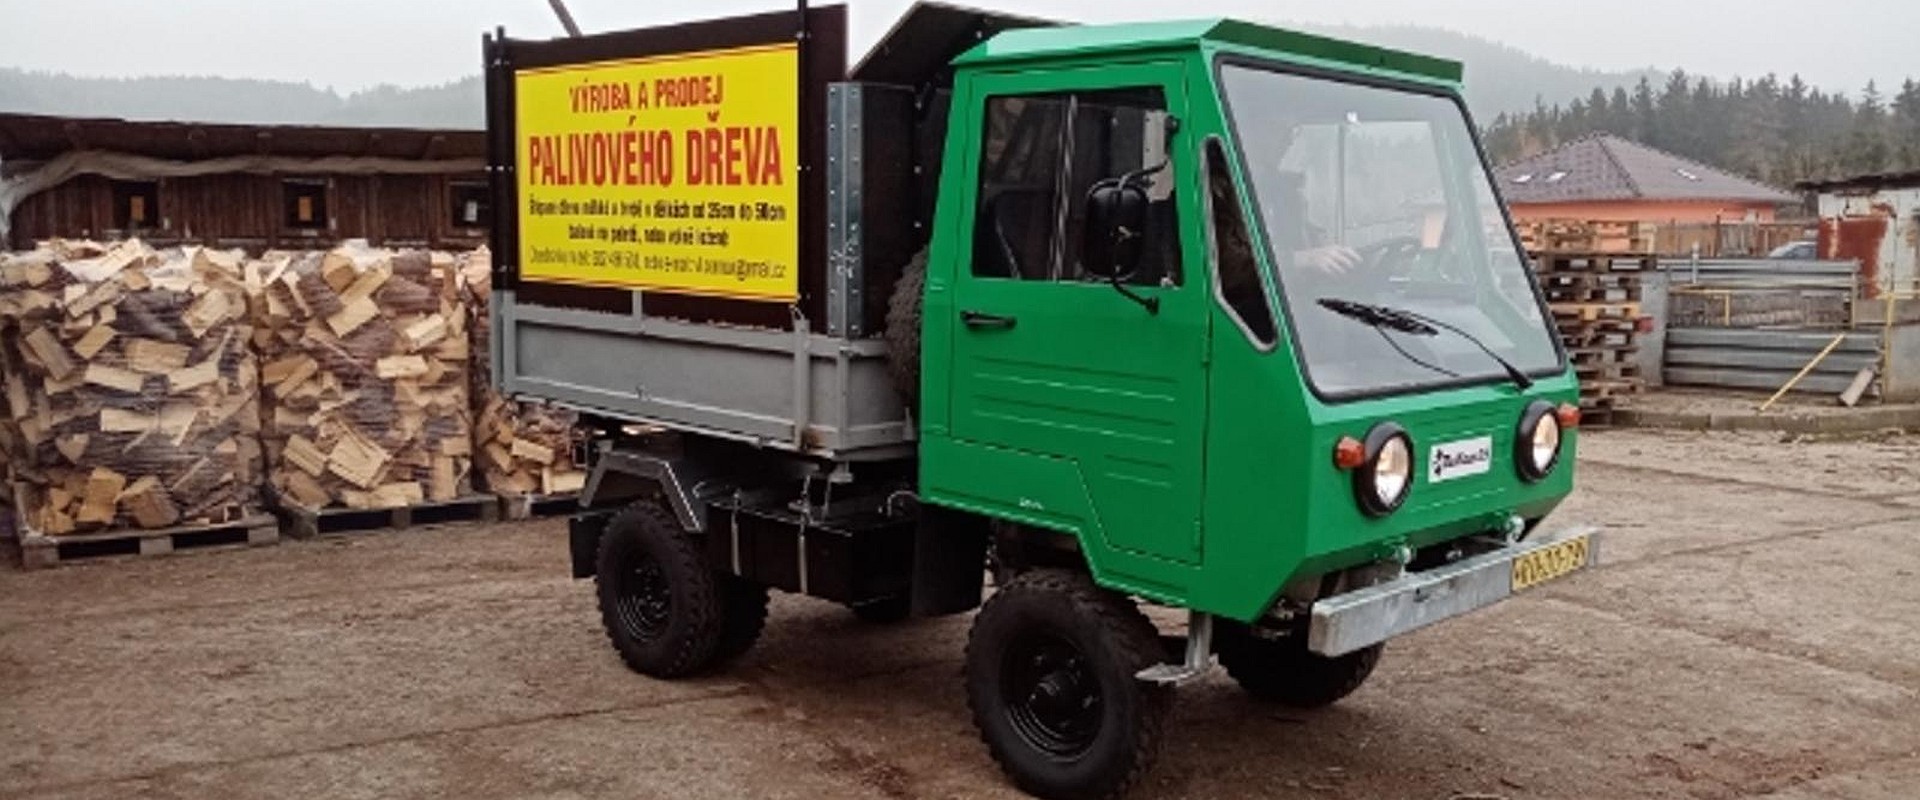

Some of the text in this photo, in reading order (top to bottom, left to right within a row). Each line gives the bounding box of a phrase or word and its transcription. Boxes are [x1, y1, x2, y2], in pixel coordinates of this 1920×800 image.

[569, 75, 723, 113] VÝROBA A PRODEJ
[529, 111, 783, 187] PALIVOVÉHO DŘEVA
